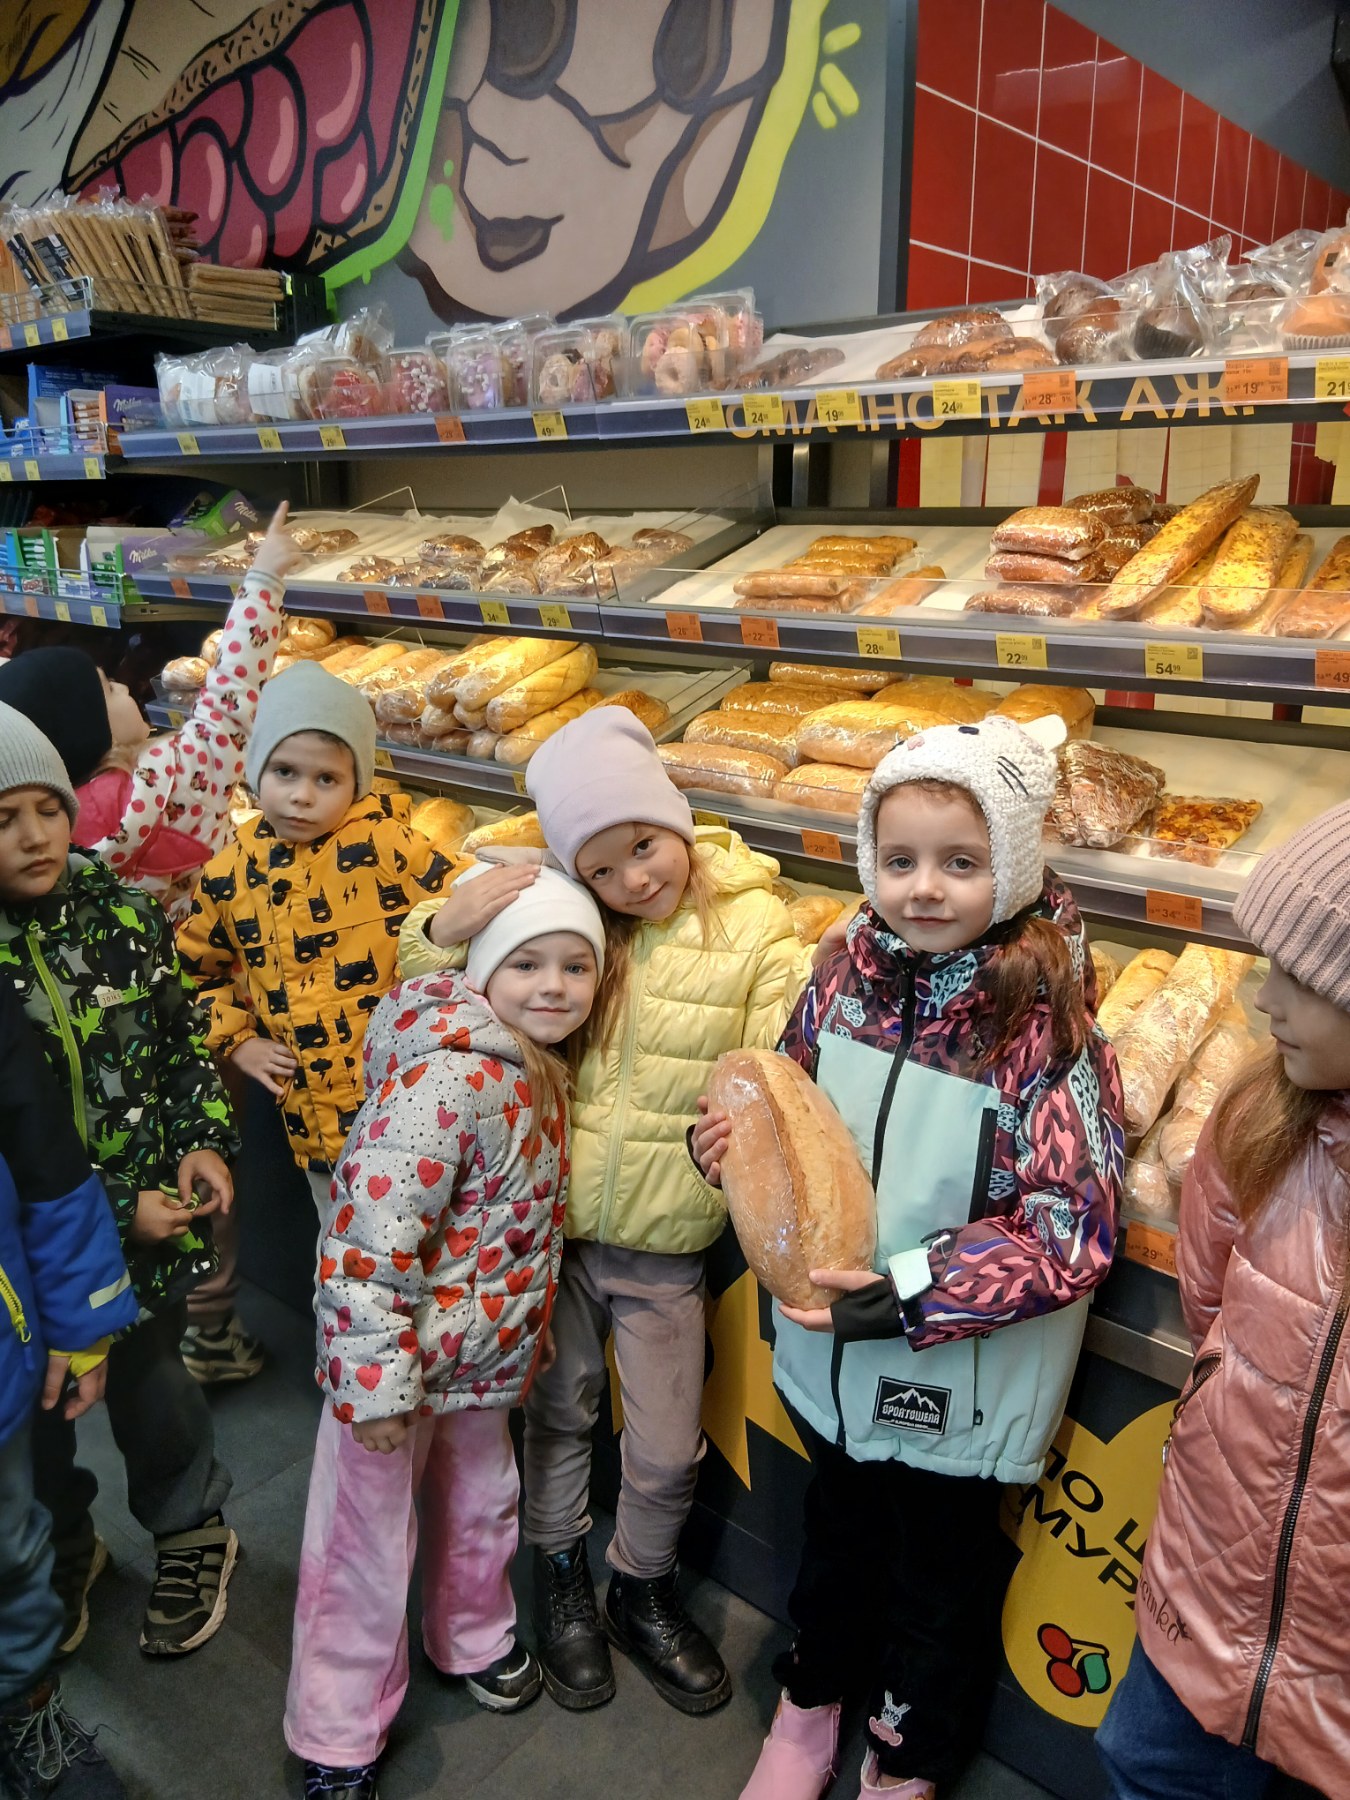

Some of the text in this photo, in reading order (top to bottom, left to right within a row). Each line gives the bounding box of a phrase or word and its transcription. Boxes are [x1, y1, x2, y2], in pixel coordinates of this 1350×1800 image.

[1243, 382, 1258, 394] 19
[1327, 381, 1345, 396] 21
[1039, 393, 1052, 404] 28
[942, 401, 957, 414] 24
[752, 412, 764, 424] 24
[825, 409, 838, 421] 19
[695, 417, 706, 429] 24
[865, 643, 879, 655] 28
[1006, 652, 1021, 664] 22
[1155, 662, 1173, 675] 54
[1333, 672, 1350, 683] 49
[1142, 1246, 1157, 1260] 29
[1018, 1483, 1138, 1612] МУР
